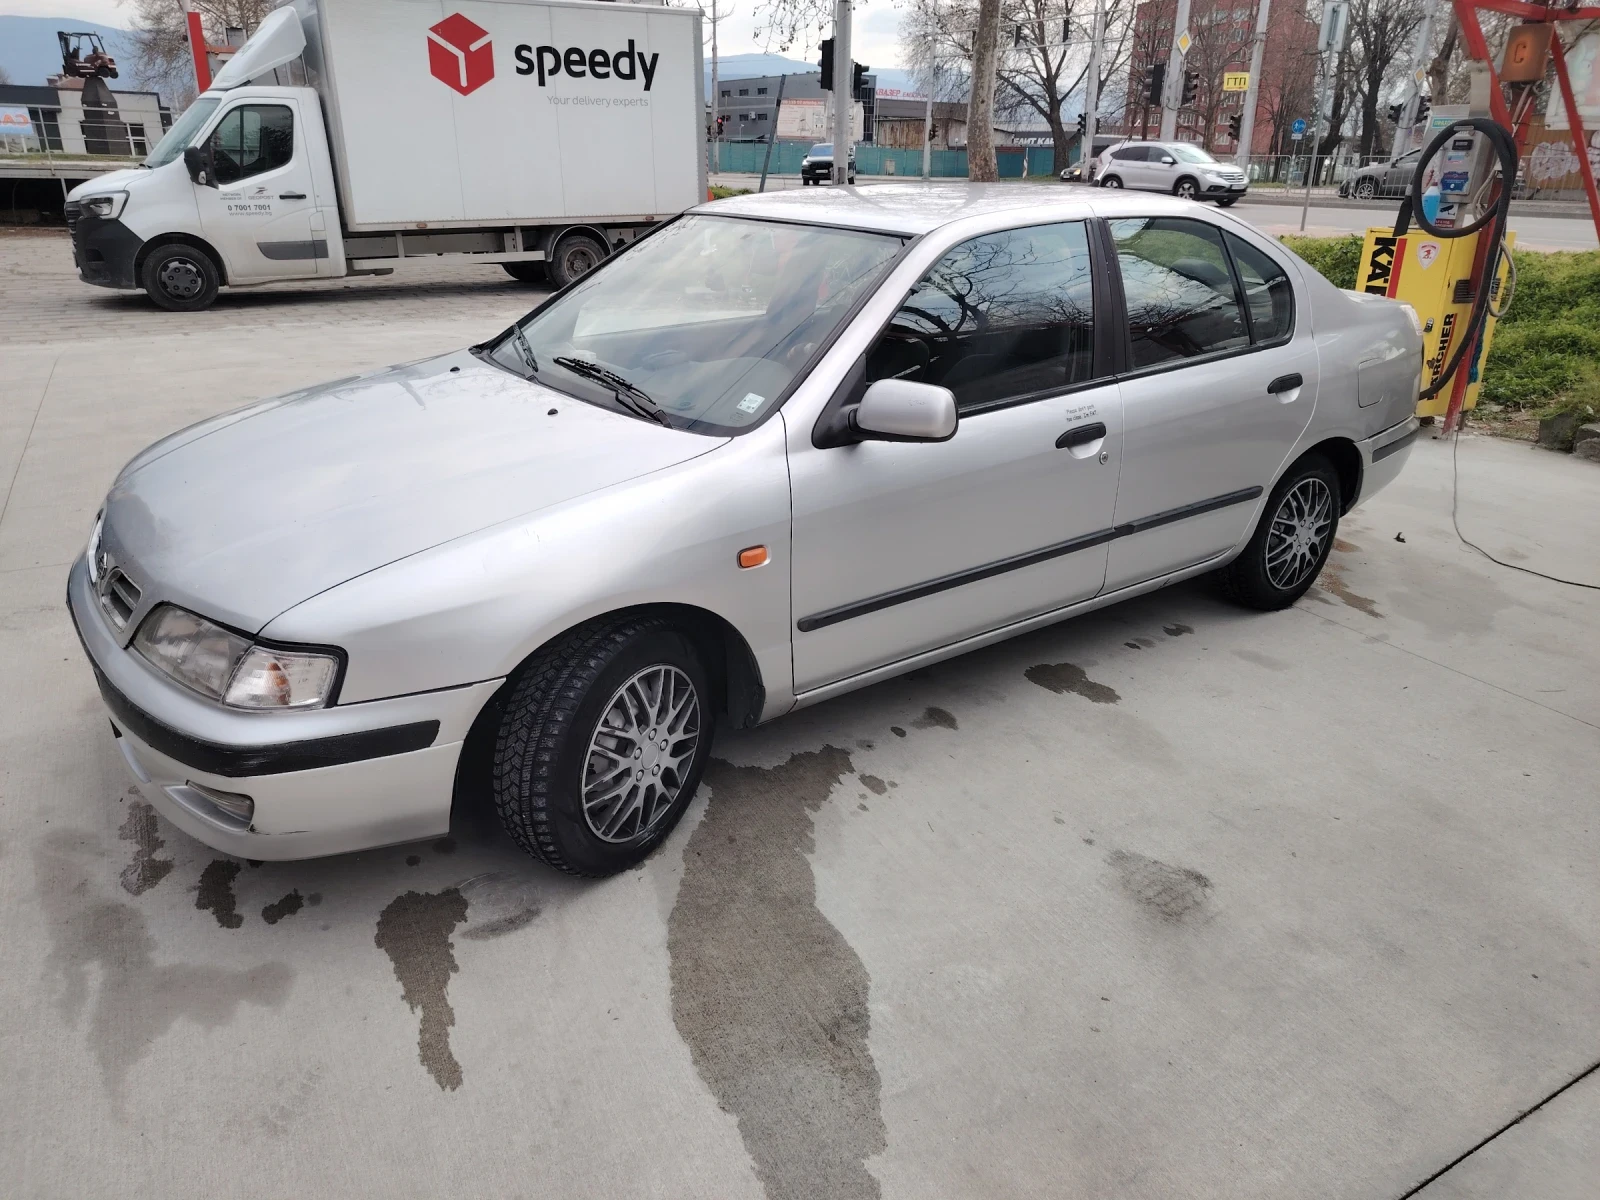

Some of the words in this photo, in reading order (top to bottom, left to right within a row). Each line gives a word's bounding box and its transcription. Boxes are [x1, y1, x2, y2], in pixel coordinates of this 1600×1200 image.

[514, 39, 659, 91] speedy
[1227, 77, 1246, 86] ГТП
[547, 96, 570, 105] Your
[572, 96, 611, 108] delivery
[612, 97, 649, 108] experts
